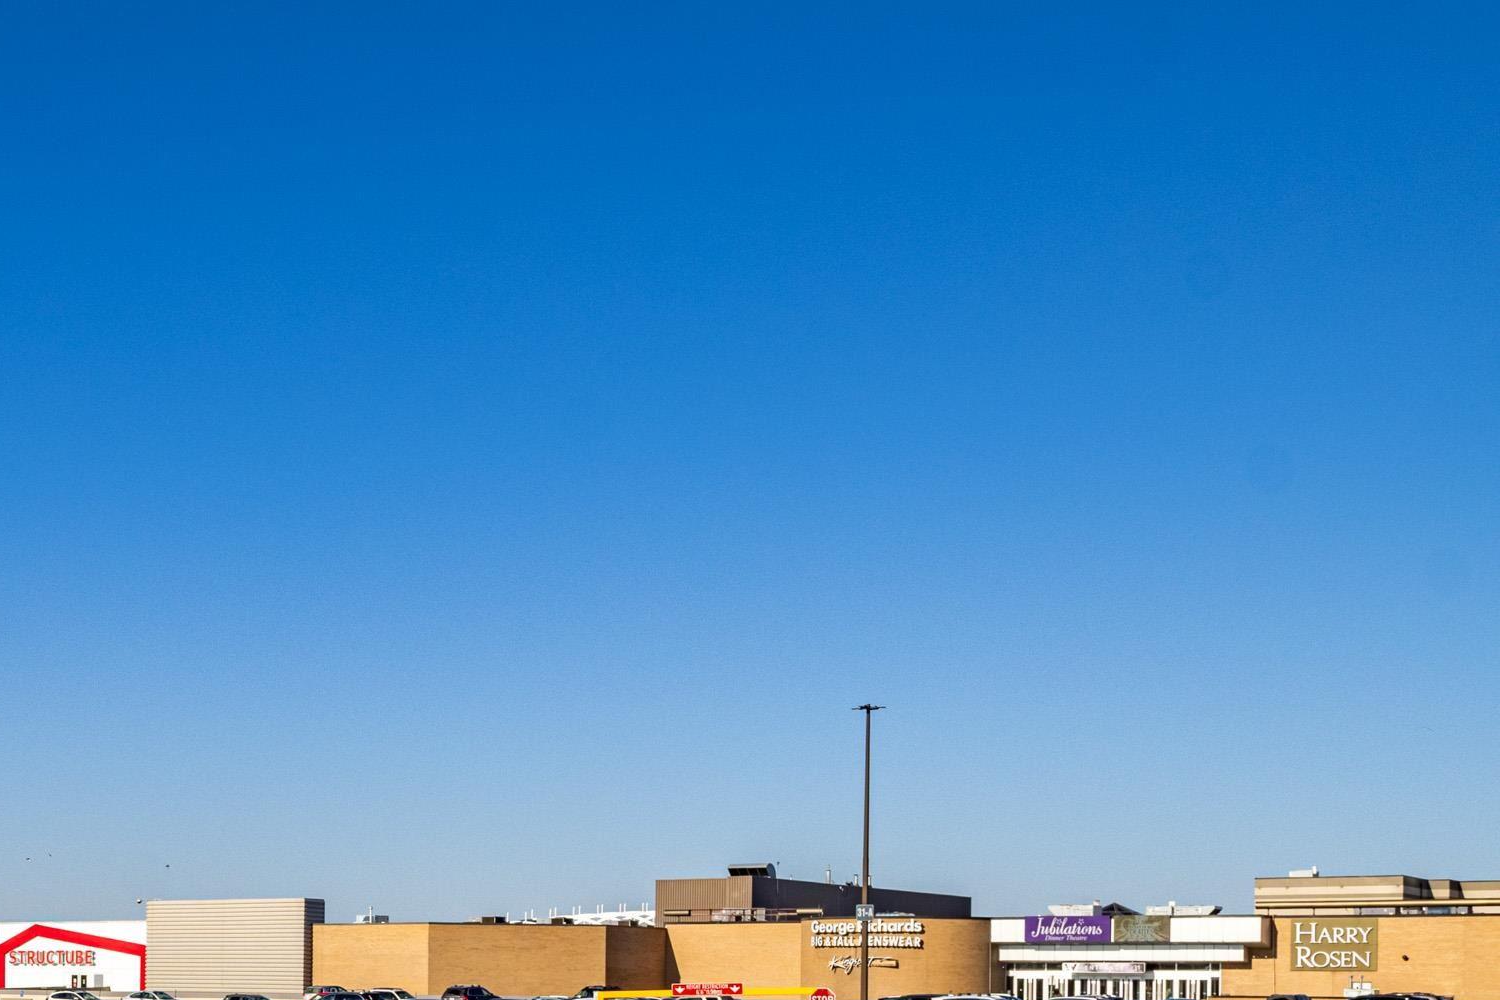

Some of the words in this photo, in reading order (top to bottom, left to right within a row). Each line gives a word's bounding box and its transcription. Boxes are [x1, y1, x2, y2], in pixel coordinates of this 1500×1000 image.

[857, 907, 874, 918] 31-A
[811, 920, 854, 935] George
[1031, 915, 1103, 938] Jubilations
[1293, 922, 1373, 944] HARRY
[810, 935, 823, 947] BIG
[831, 935, 855, 947] TALL
[8, 950, 95, 965] STRUCTUBE
[1295, 946, 1372, 968] ROSEN
